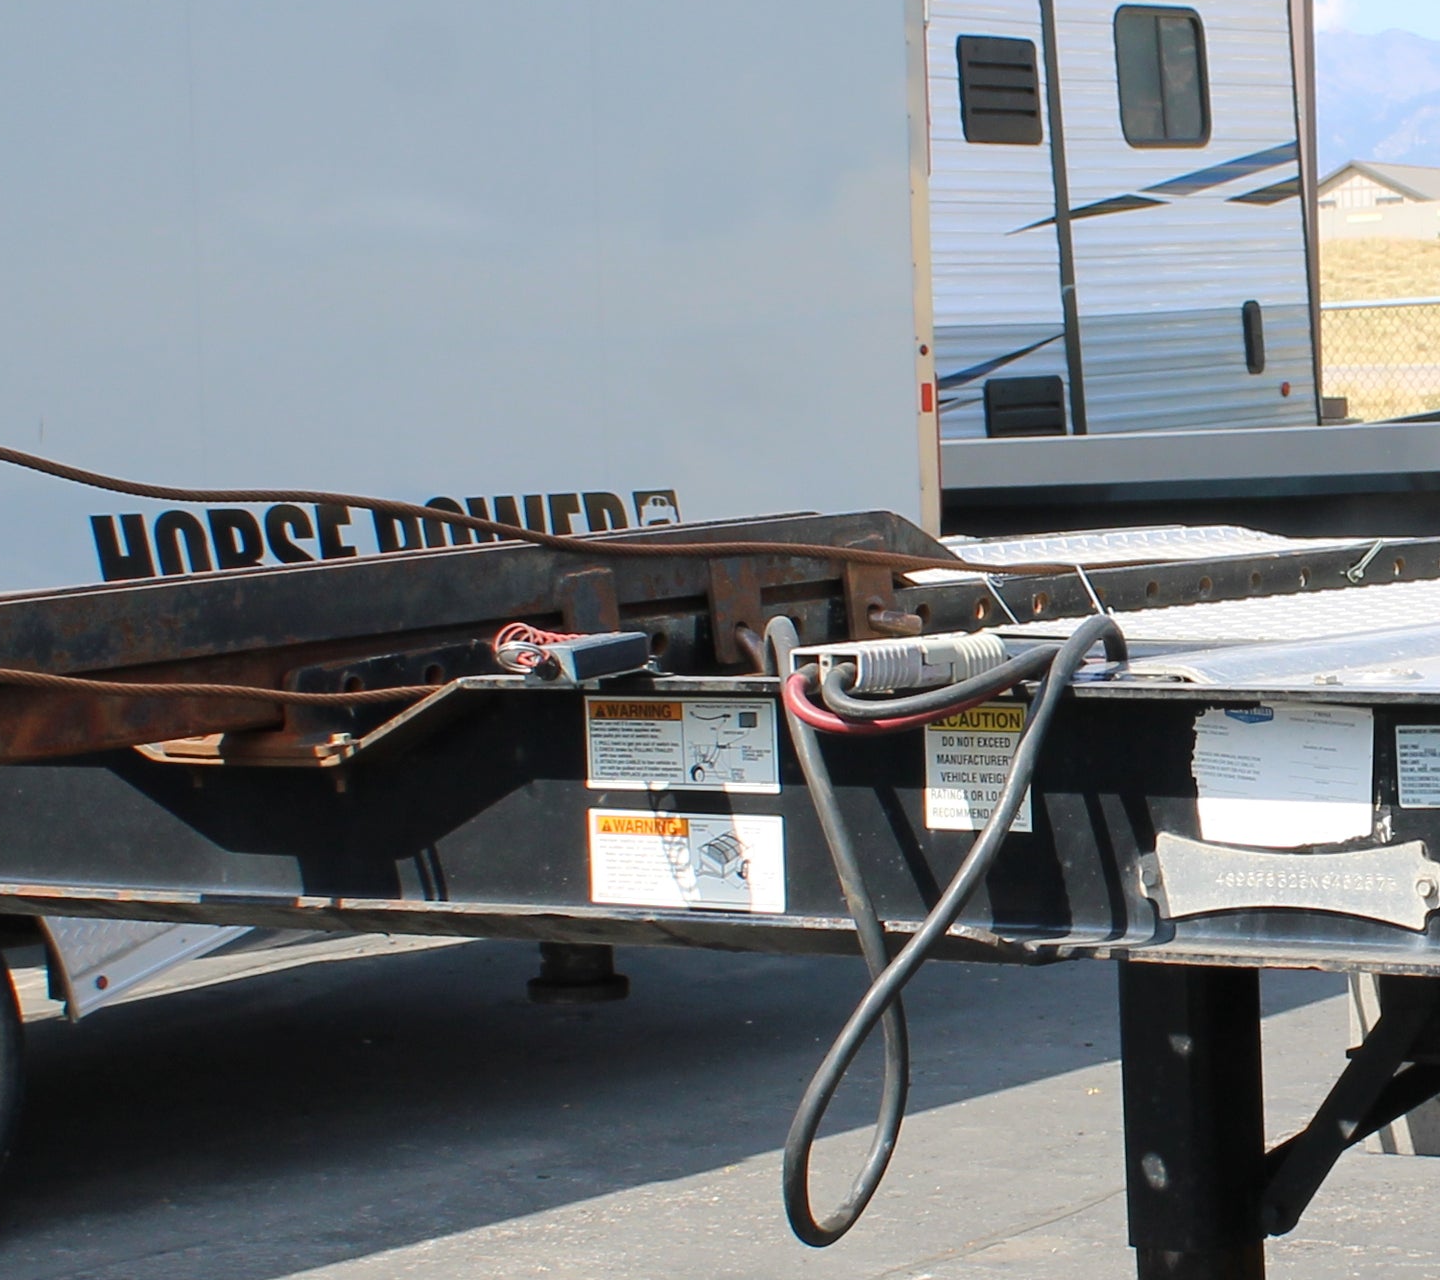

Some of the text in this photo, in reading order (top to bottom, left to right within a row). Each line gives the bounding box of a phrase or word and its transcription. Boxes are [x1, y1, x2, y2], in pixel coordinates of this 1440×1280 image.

[607, 704, 672, 718] WARNING
[947, 712, 1021, 728] CAUTION
[942, 736, 1011, 748] DO NOT EXCEED
[940, 772, 977, 783] VEHICLE
[931, 789, 968, 801] RATINGS
[971, 790, 984, 801] OR
[613, 818, 677, 835] WARNING
